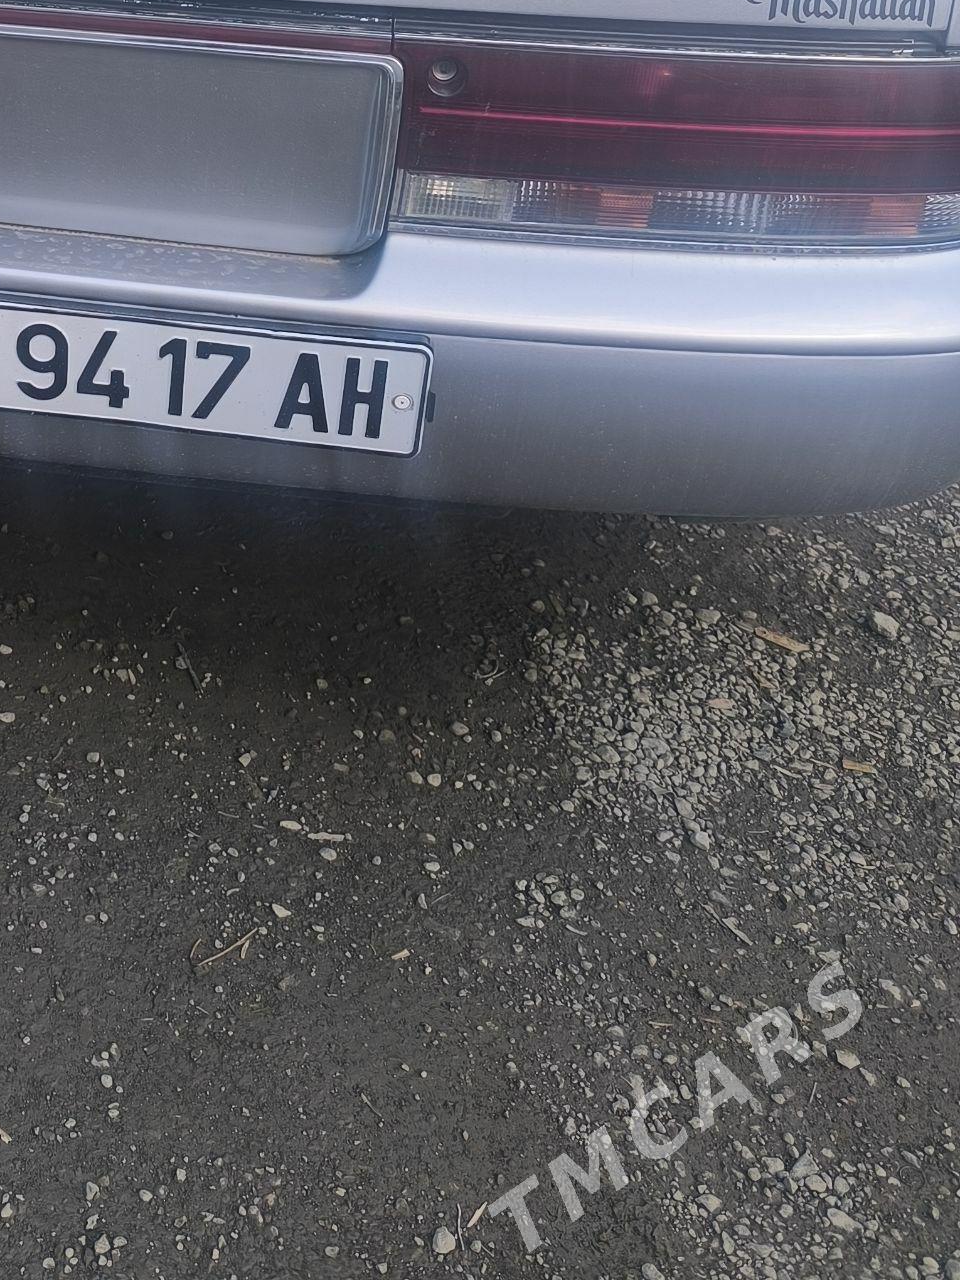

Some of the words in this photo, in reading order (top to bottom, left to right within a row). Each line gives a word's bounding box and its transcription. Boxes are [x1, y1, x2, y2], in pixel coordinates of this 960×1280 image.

[15, 322, 131, 409] 94
[158, 336, 252, 419] 17
[273, 352, 390, 438] AH
